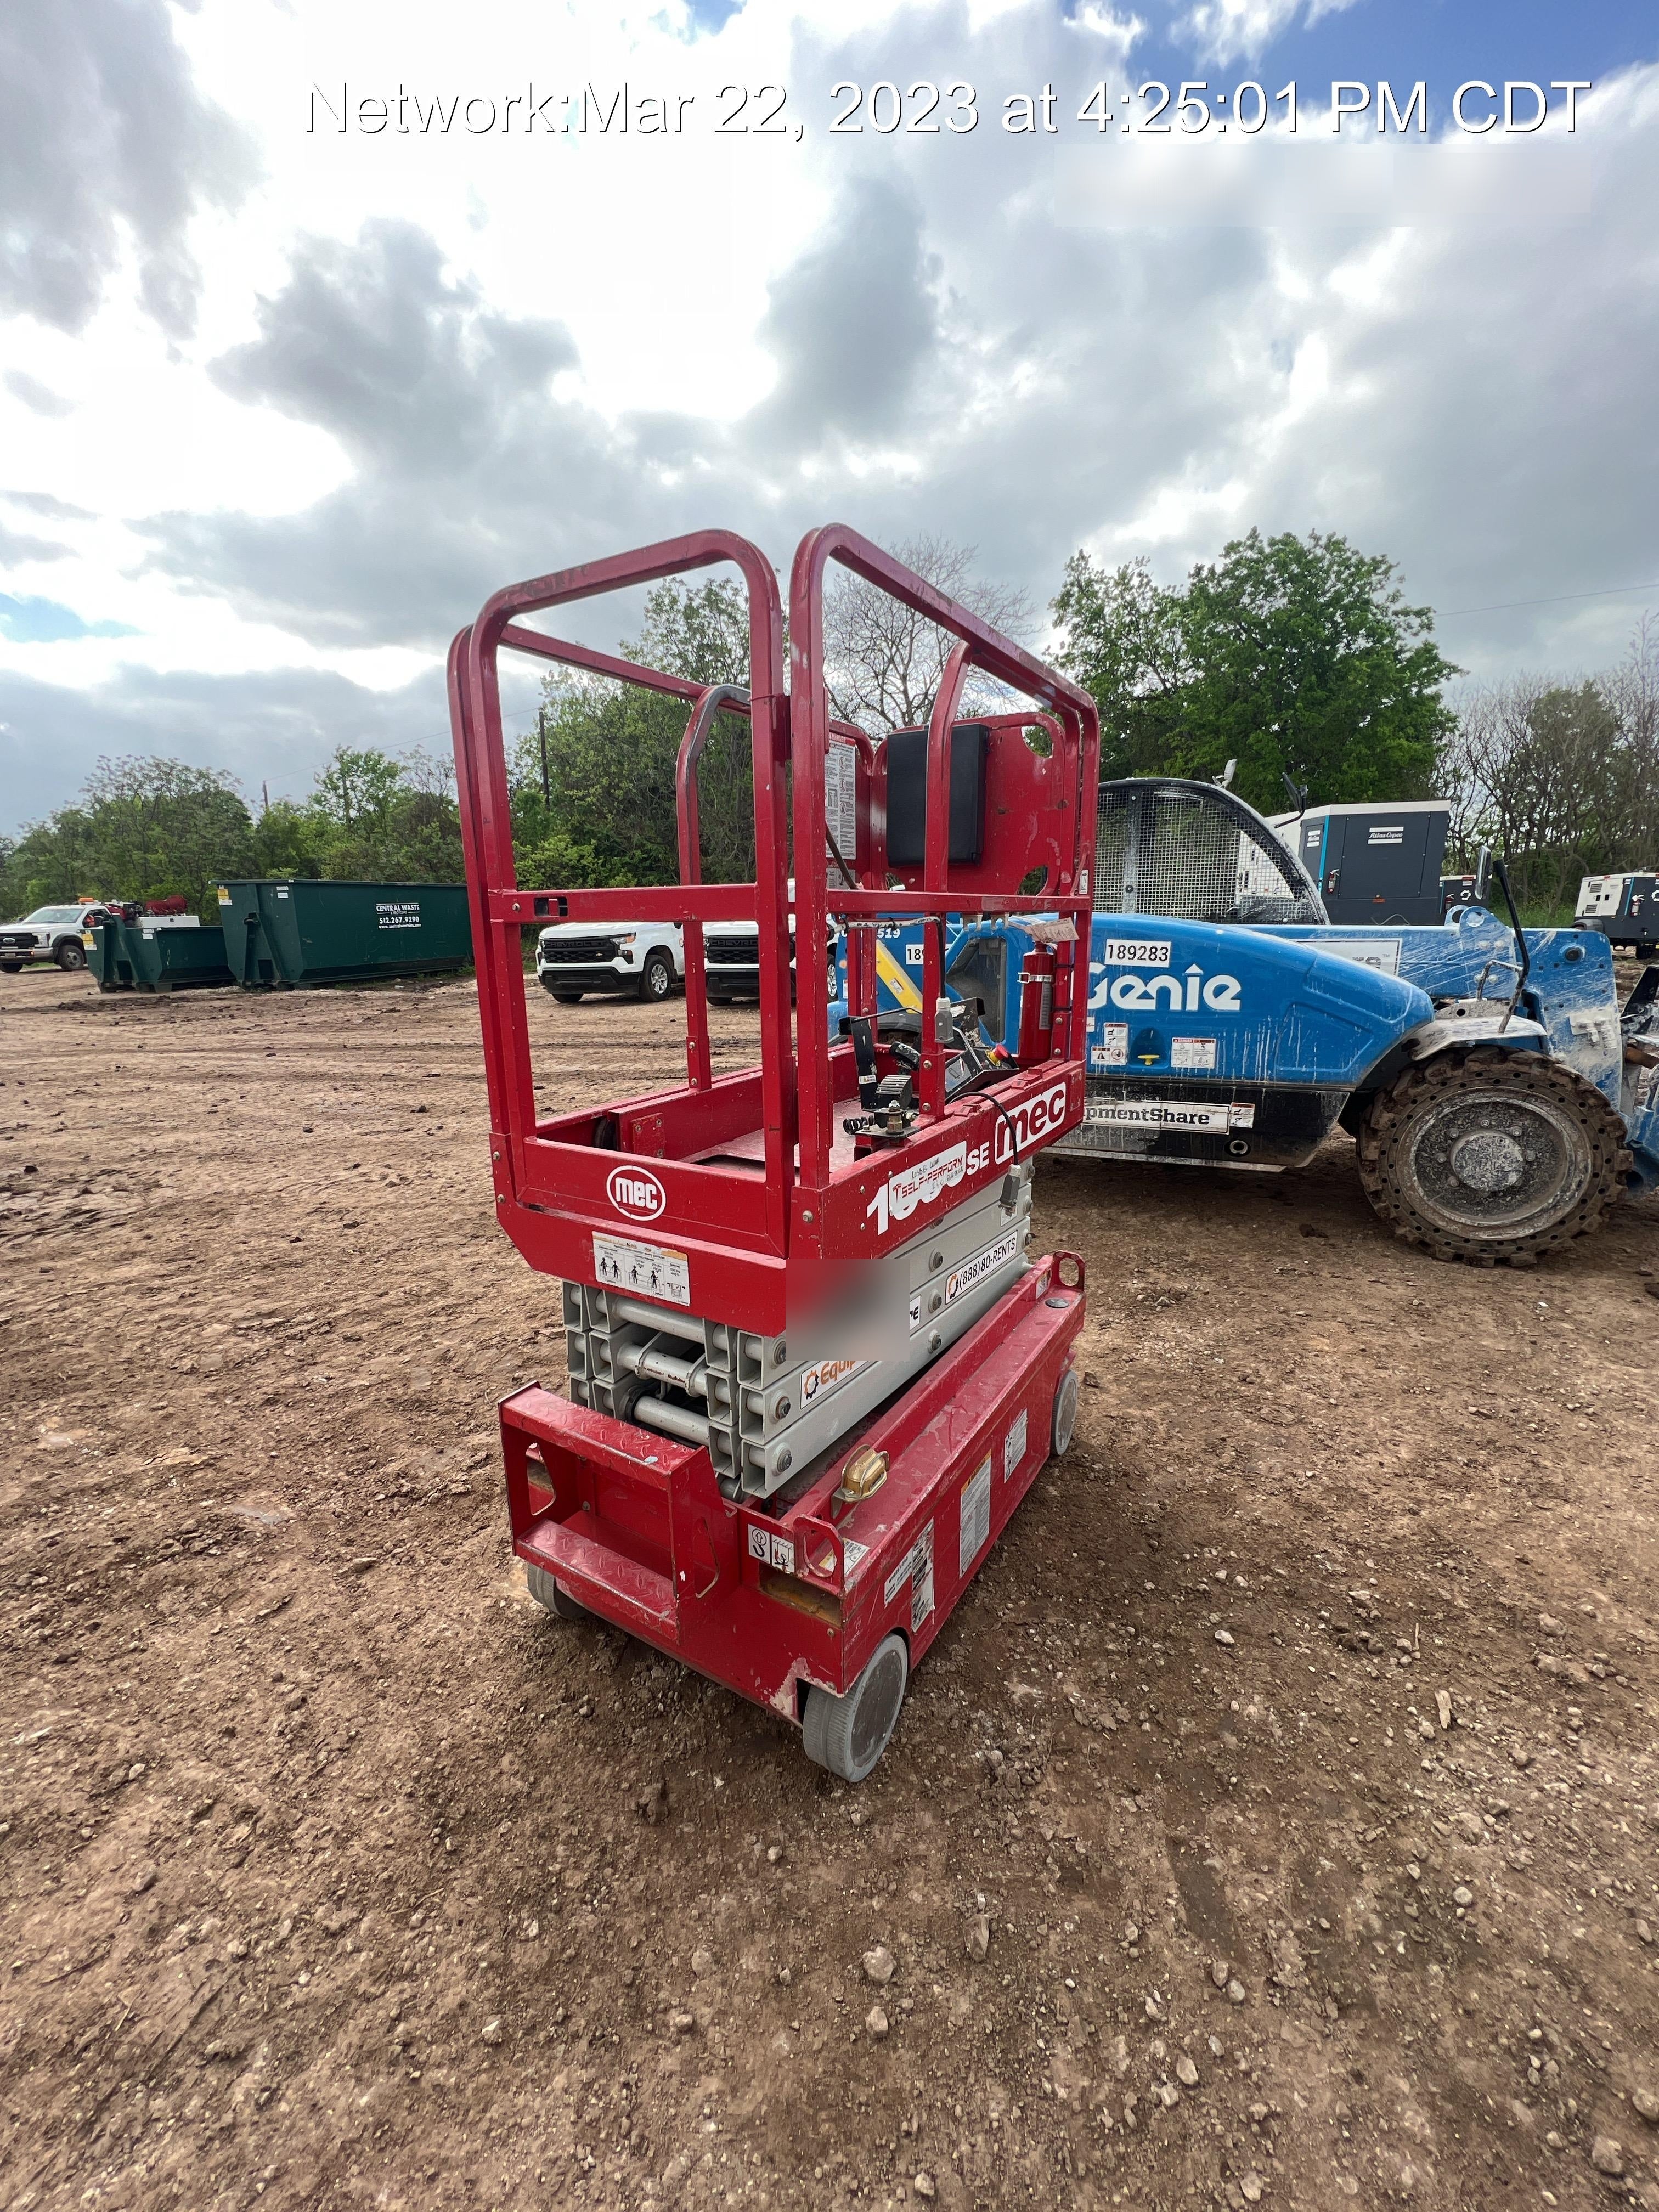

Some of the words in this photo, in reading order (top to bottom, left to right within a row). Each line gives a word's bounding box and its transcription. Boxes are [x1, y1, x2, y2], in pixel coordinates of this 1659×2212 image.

[379, 916, 420, 924] 512.267.9290
[1108, 944, 1169, 962] 189283
[1071, 963, 1242, 1011] Genie
[996, 1089, 1065, 1161] mec
[1084, 1106, 1210, 1125] pmentShare
[614, 1176, 658, 1210] mec
